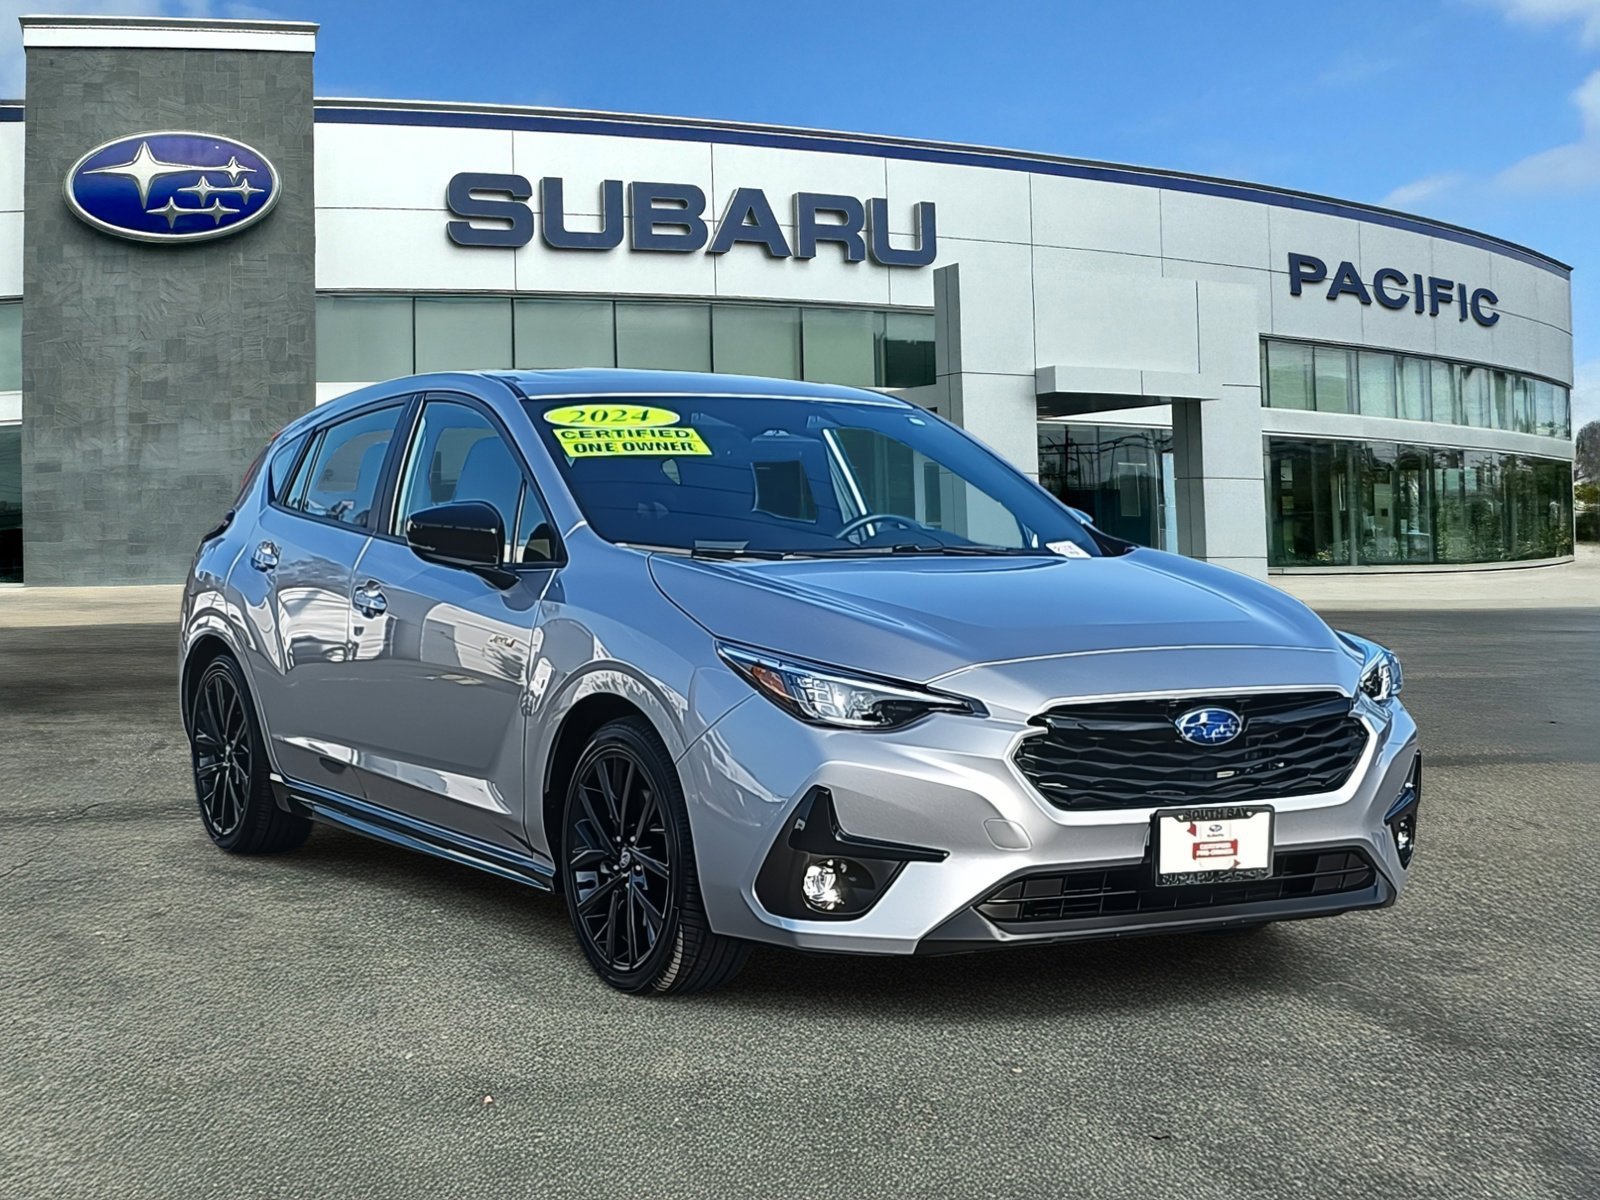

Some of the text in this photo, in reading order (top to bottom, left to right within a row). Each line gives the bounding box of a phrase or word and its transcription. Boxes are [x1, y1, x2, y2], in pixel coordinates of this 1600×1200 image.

[447, 171, 938, 267] SUBARU
[1288, 252, 1500, 327] PACIFIC
[568, 409, 651, 424] 2024
[560, 429, 691, 440] CERTIFIED
[573, 441, 696, 454] ONE OWNER
[1185, 808, 1224, 820] SOUTH
